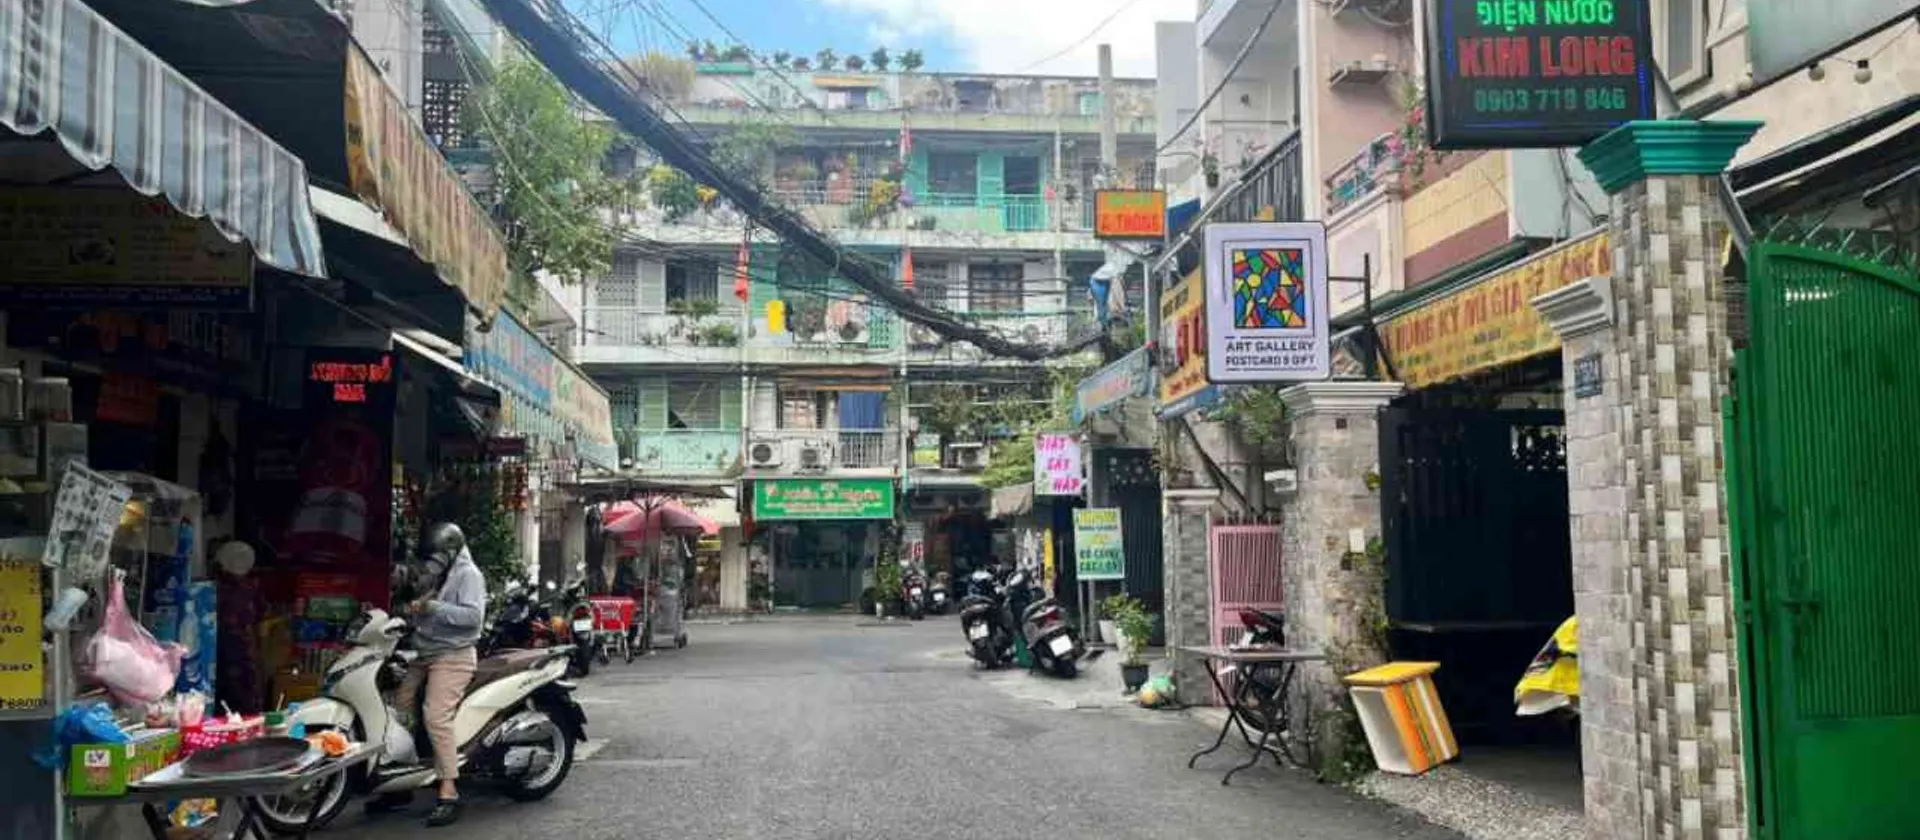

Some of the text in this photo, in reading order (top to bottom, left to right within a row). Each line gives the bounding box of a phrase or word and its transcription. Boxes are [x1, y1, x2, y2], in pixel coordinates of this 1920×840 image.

[1457, 36, 1635, 77] KIM LONG
[1474, 89, 1530, 112] 0903
[1226, 340, 1315, 352] ART GALLERY
[1226, 355, 1282, 366] POSTCARD
[1291, 354, 1315, 365] GIFT
